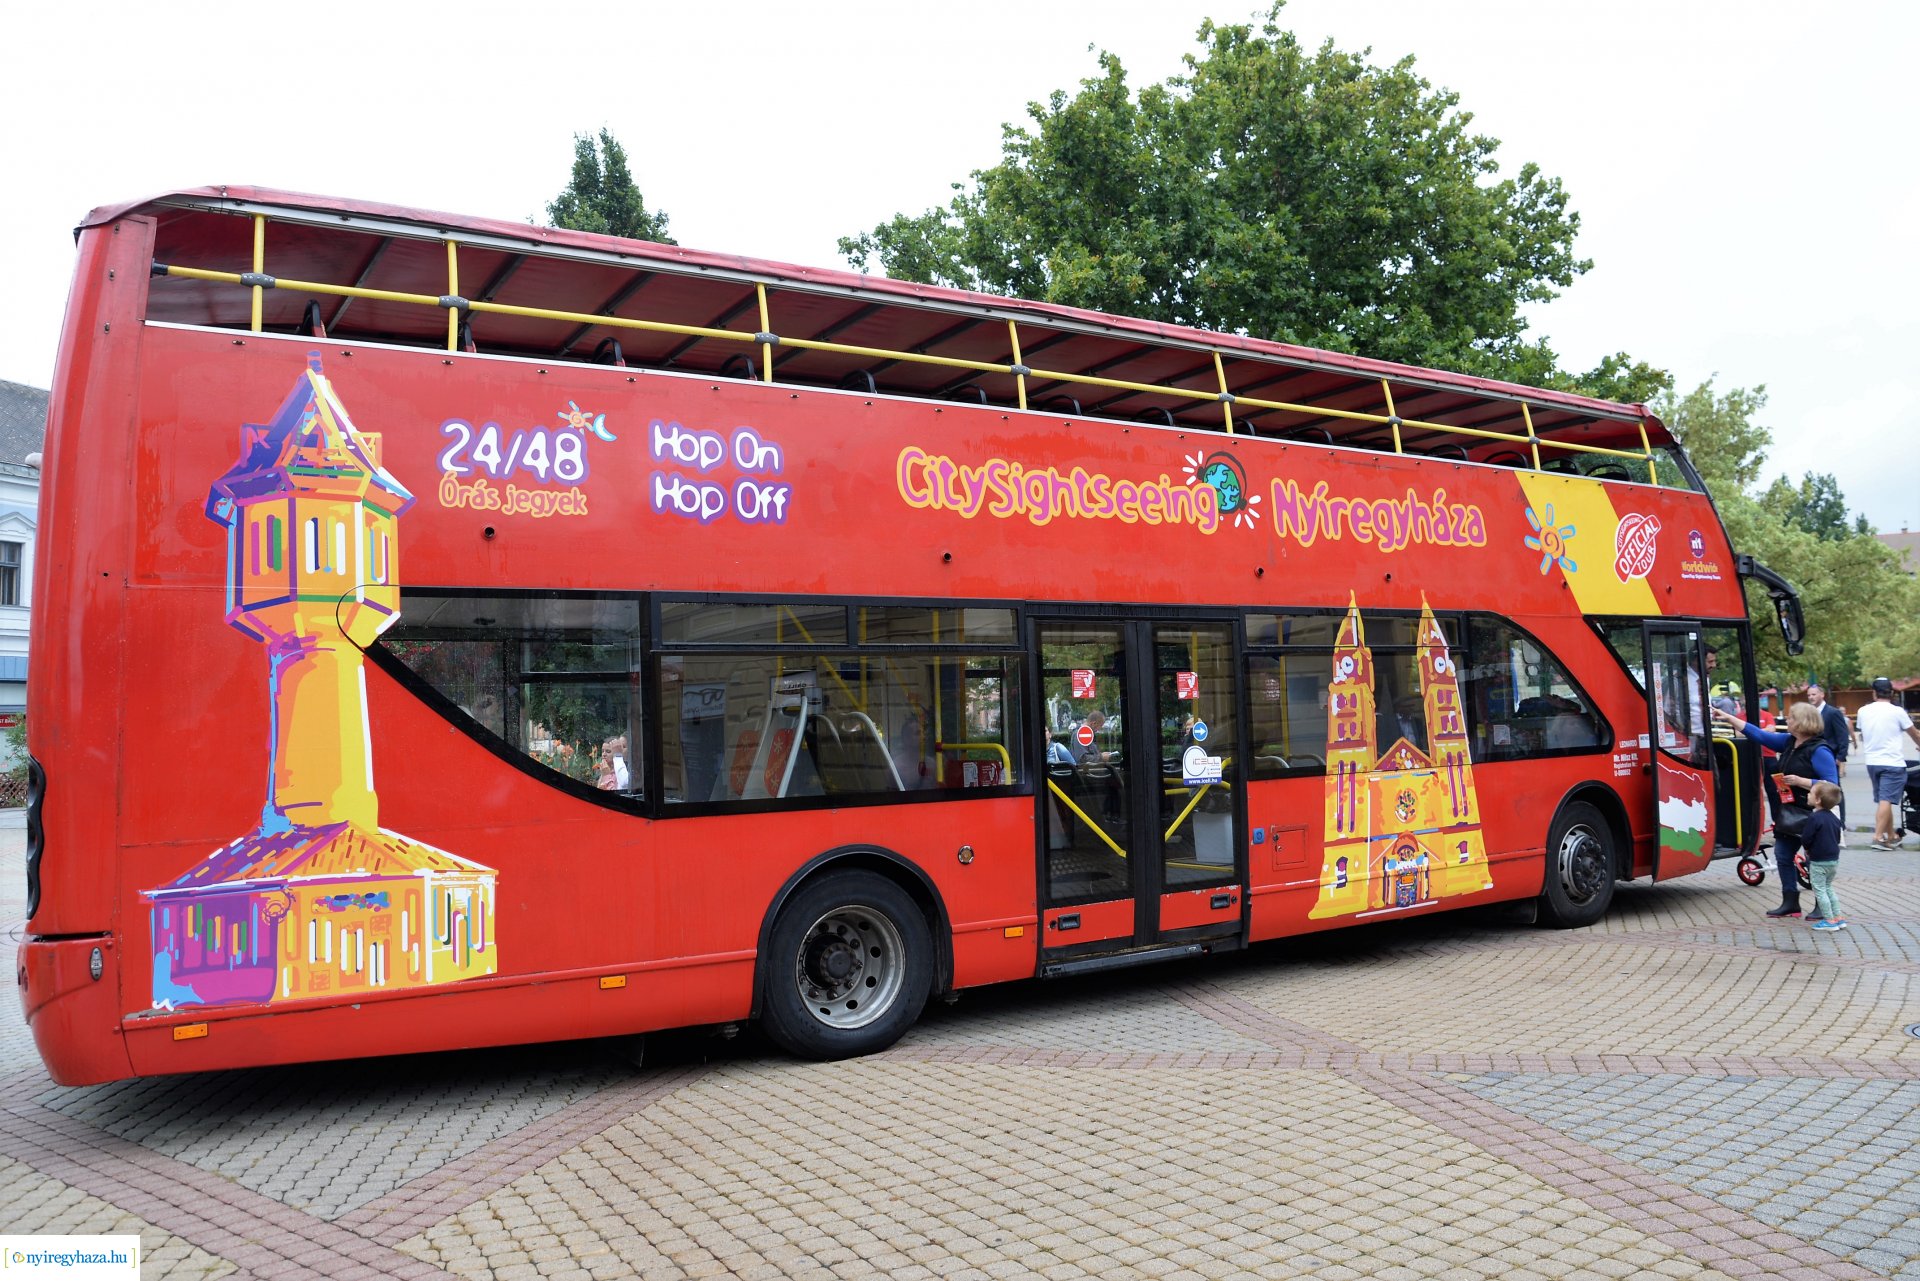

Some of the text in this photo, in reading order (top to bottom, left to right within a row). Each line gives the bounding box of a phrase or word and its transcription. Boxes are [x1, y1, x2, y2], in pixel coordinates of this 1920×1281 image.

[439, 421, 587, 483] 24/48
[652, 421, 784, 473] Hop On
[440, 472, 587, 516] Órás jegyek
[651, 472, 790, 523] Hop Off
[897, 447, 1218, 534] CitySightseeing
[1271, 479, 1487, 552] Nyíregyháza
[1619, 519, 1659, 575] OFFICIAL
[1637, 546, 1655, 572] TOUR
